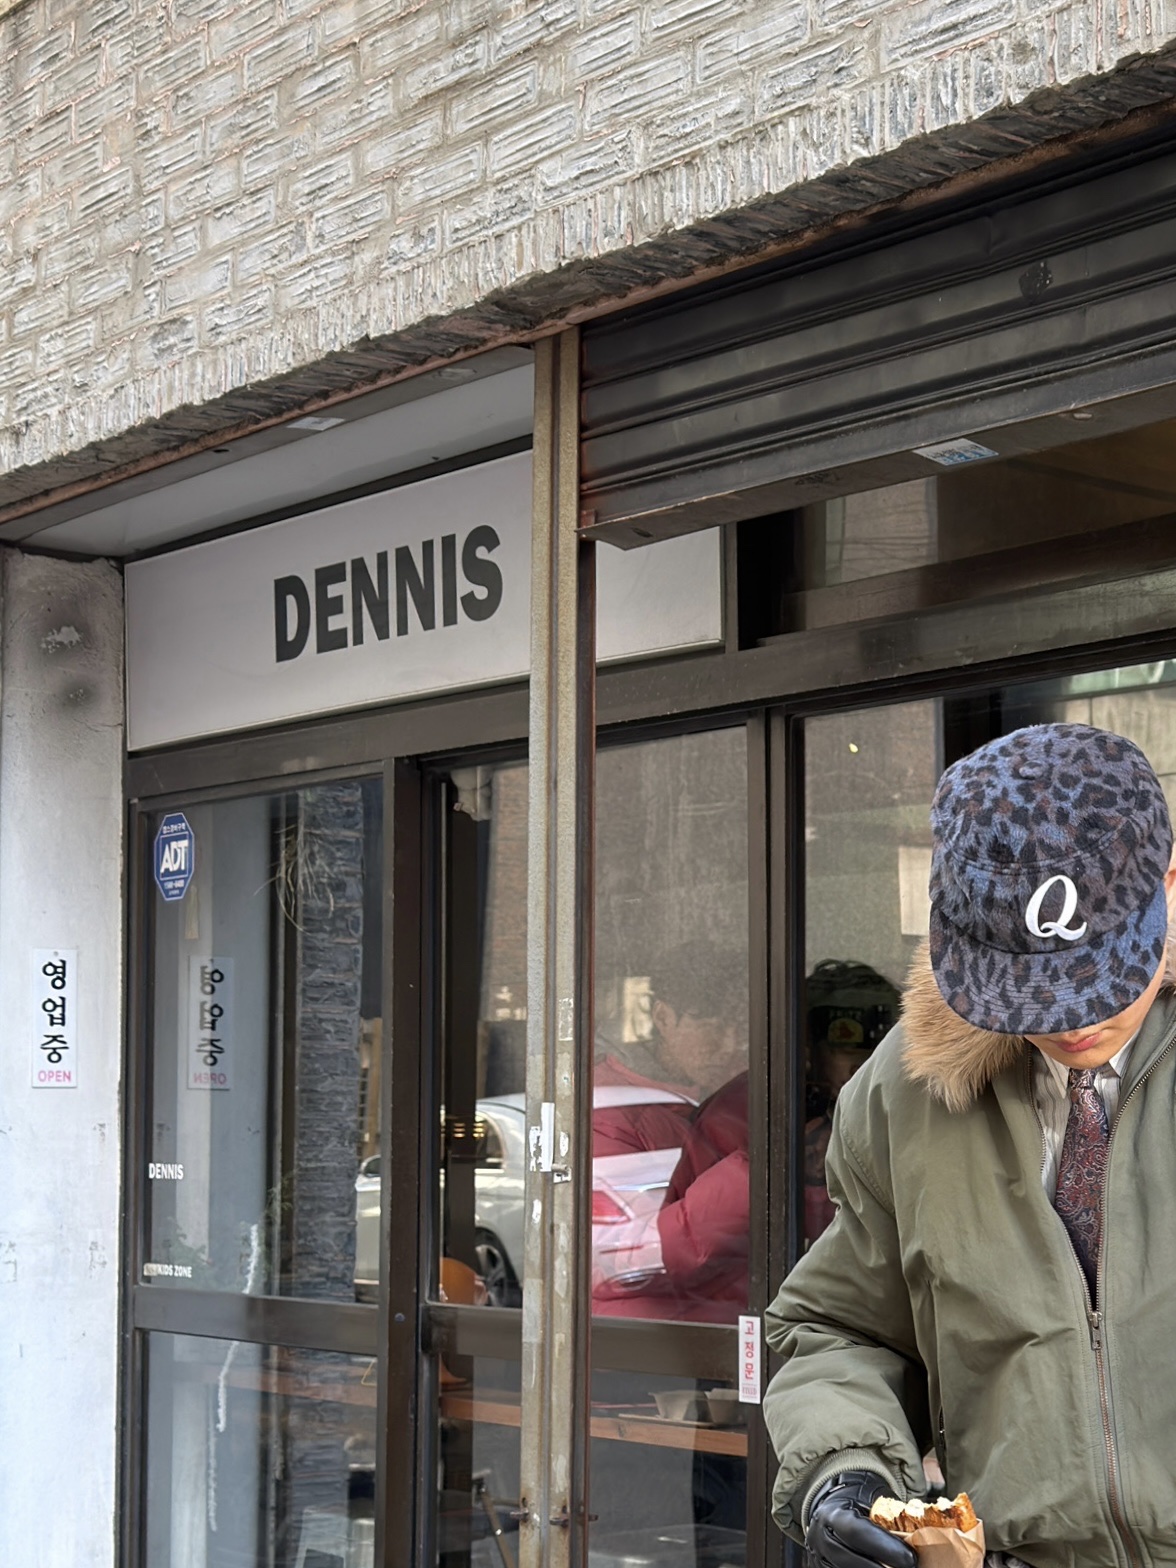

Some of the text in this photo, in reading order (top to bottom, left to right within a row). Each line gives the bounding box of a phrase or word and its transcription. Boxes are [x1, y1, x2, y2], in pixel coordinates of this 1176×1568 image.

[274, 525, 503, 663] DENNIS
[160, 839, 189, 874] ADT
[1025, 874, 1087, 941] Q
[40, 959, 69, 1064] 영업중
[38, 1070, 72, 1083] OPEN
[148, 1163, 184, 1180] DENNIS
[173, 1265, 192, 1279] ZONE
[744, 1320, 755, 1380] 고정문
